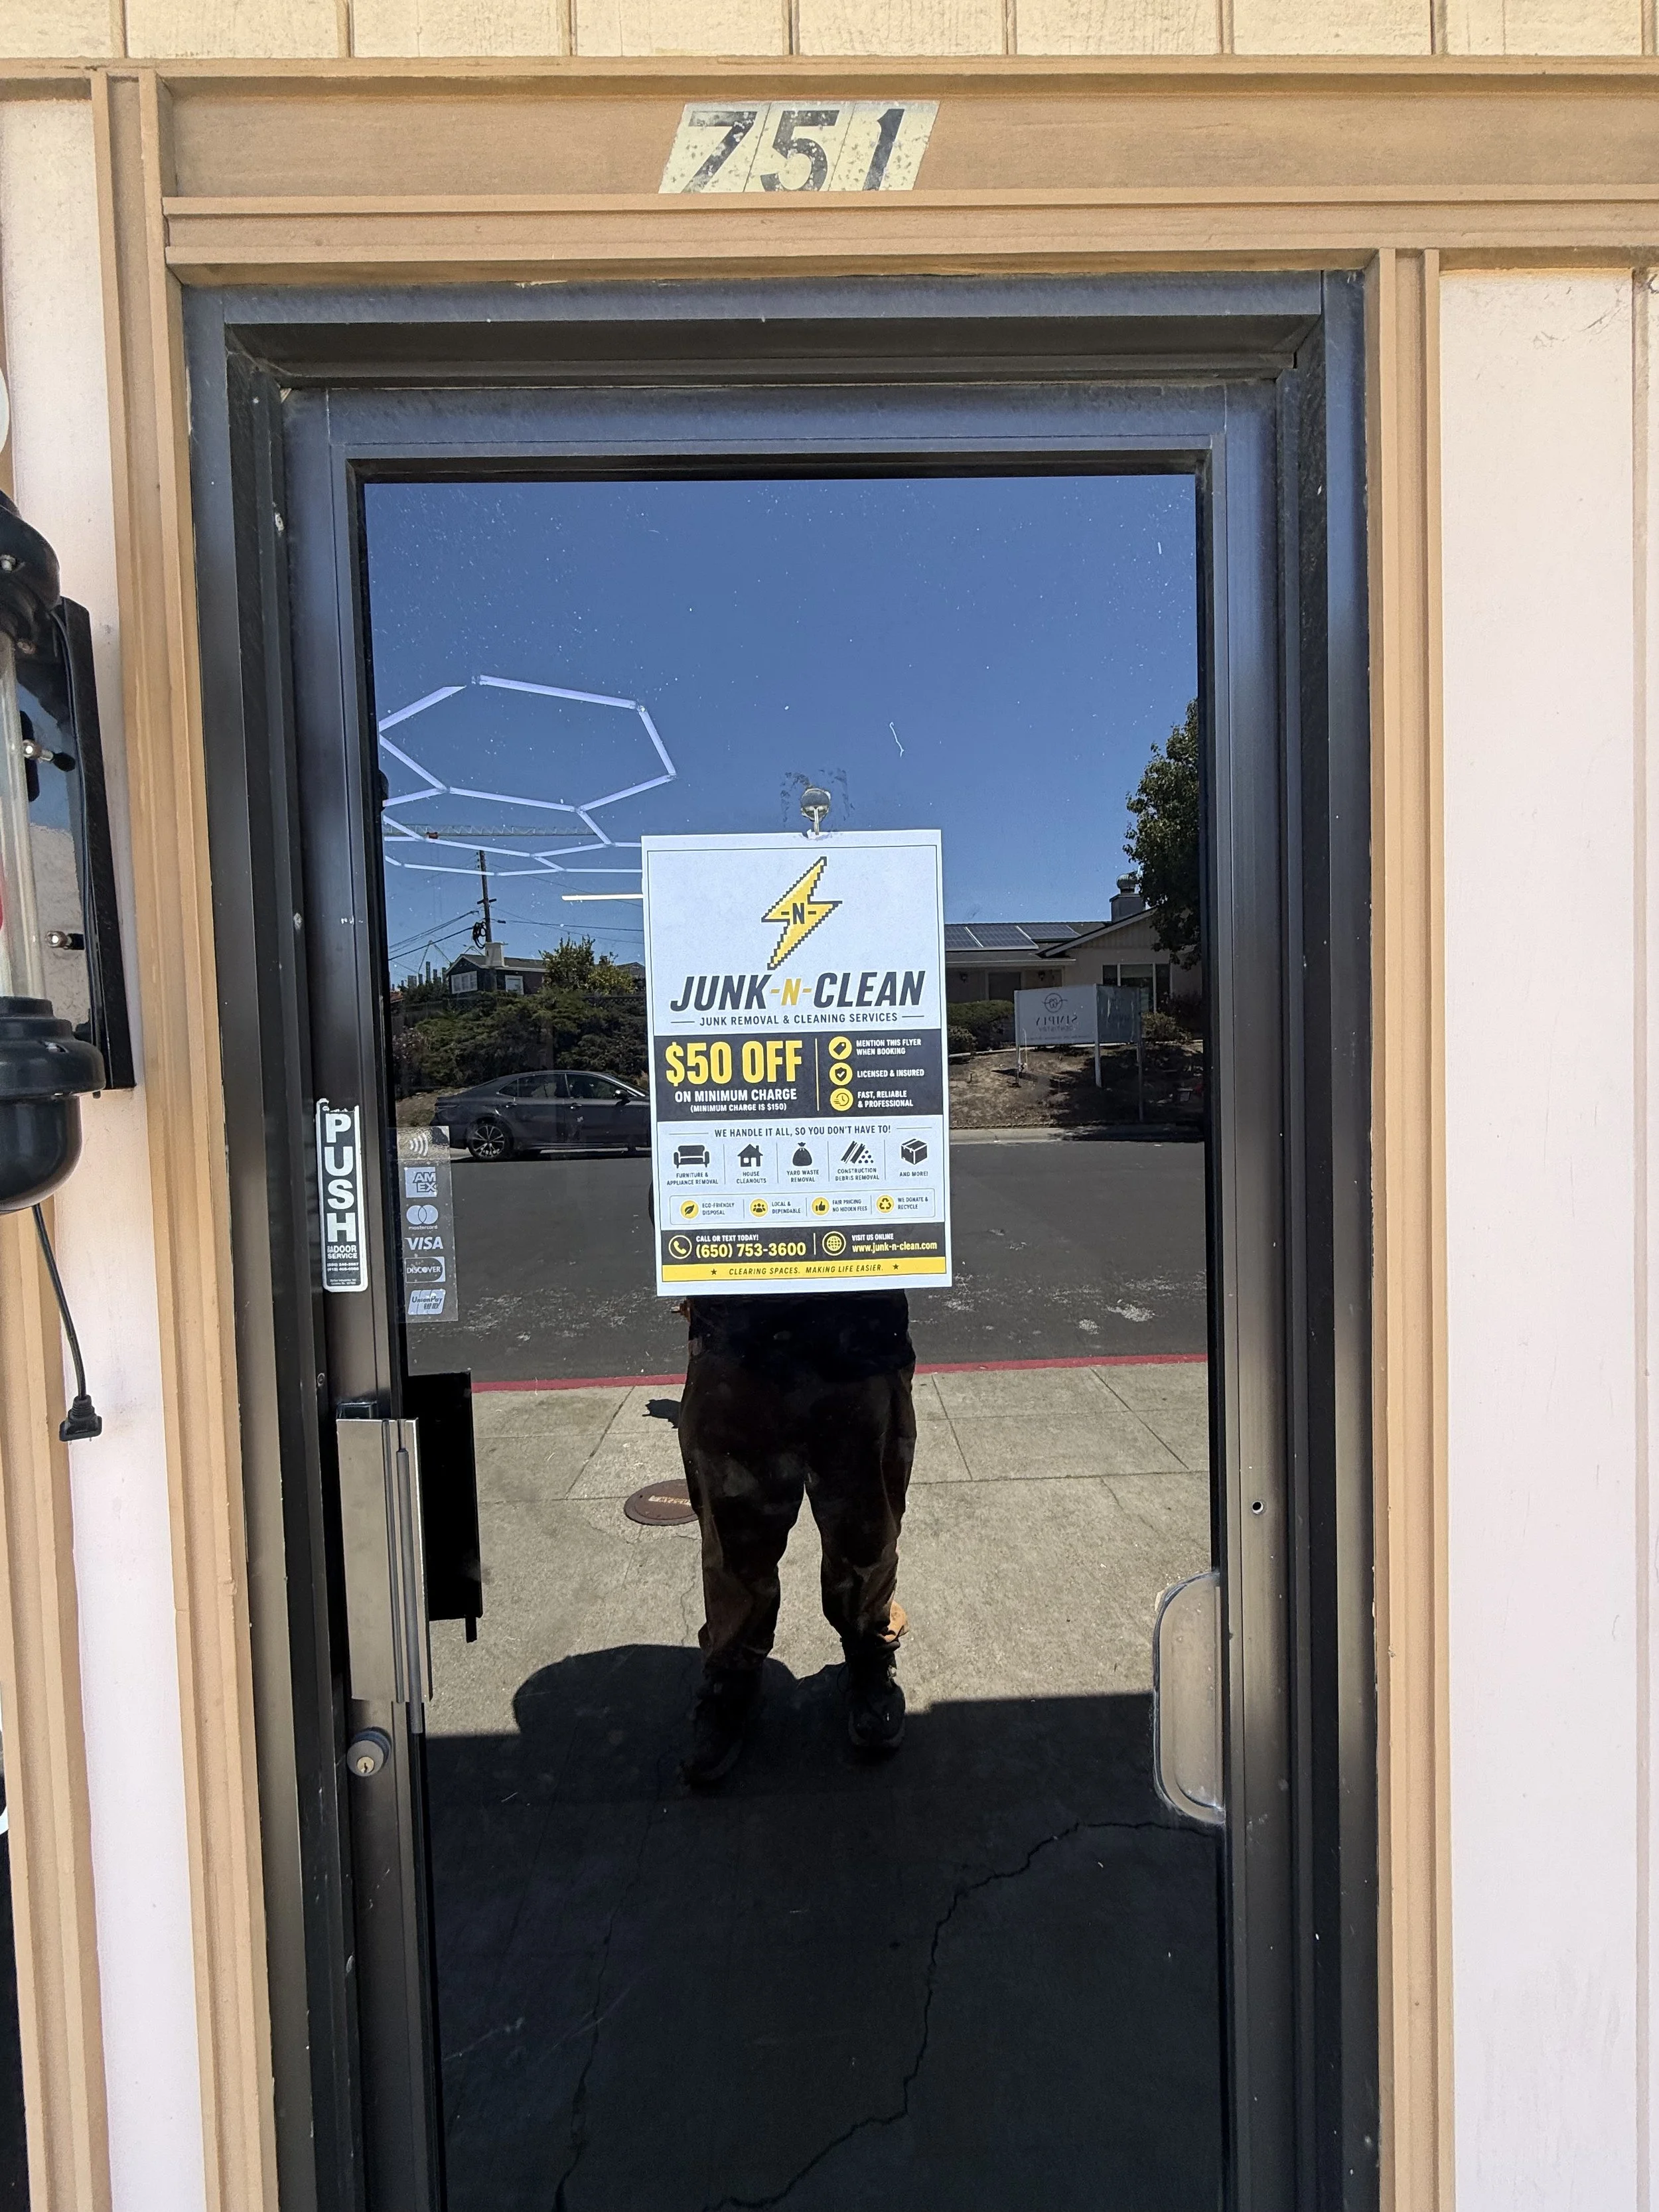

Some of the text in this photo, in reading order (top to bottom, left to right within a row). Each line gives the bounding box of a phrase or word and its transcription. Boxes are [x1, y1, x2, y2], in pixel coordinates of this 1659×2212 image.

[682, 108, 904, 192] 751
[670, 971, 926, 1011] JUNK-N-CLEAN
[699, 1013, 897, 1026] JUNK REMOVAL & CLEANING SERVICES
[665, 1041, 802, 1086] $50 OFF
[675, 1088, 797, 1102] ON MINIMUM CHARGE
[690, 1104, 727, 1113] (MINIMUM
[767, 1102, 786, 1111] $150)
[730, 1128, 762, 1137] HANDLE
[776, 1128, 792, 1137] ALL,
[325, 1114, 356, 1242] PUSH
[404, 1236, 443, 1250] VISA
[696, 1242, 806, 1258] (650) 753-3600
[852, 1241, 937, 1254] www.junk-n-clean.com
[411, 1295, 443, 1306] UnionPay
